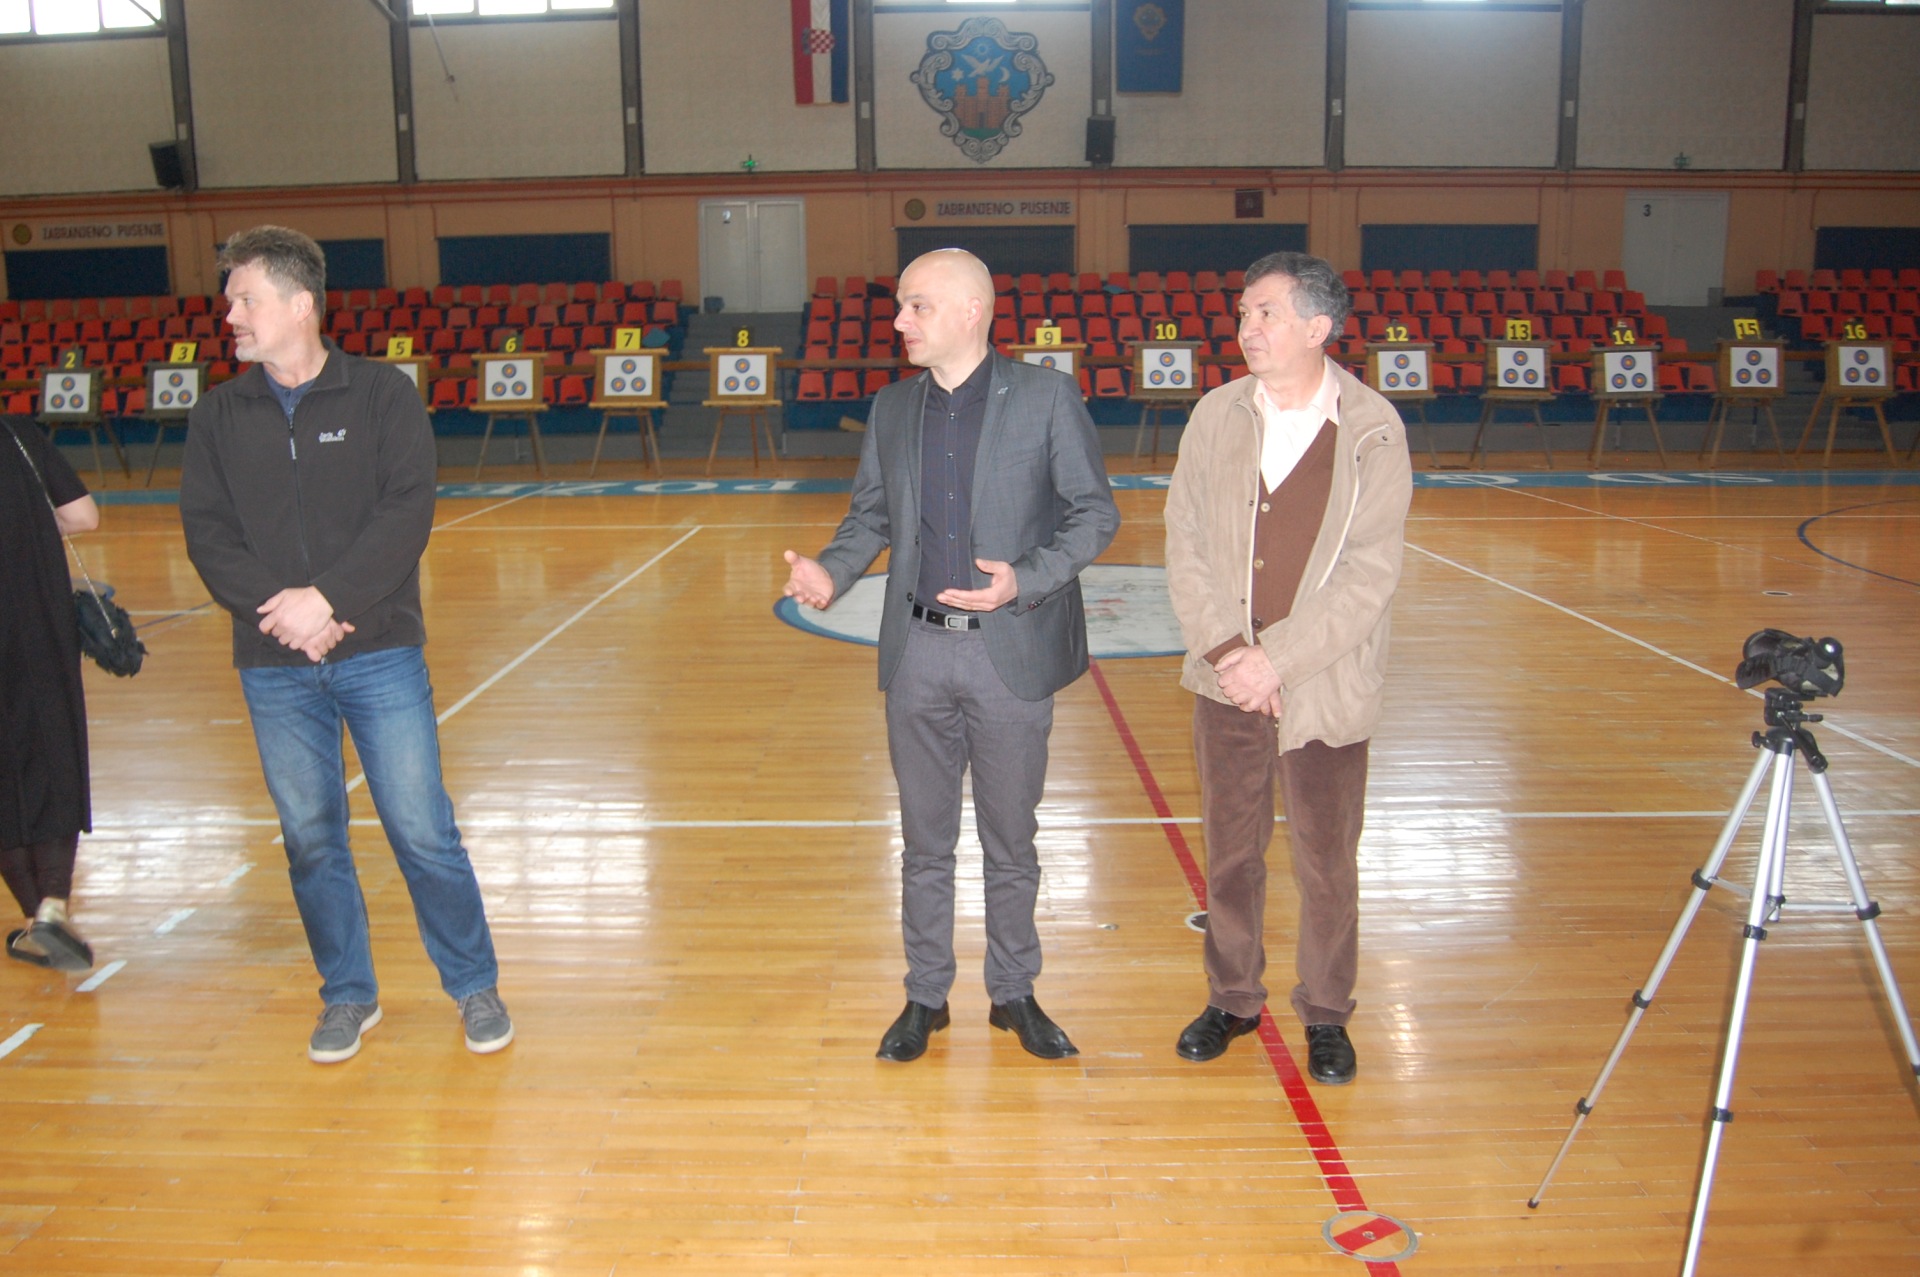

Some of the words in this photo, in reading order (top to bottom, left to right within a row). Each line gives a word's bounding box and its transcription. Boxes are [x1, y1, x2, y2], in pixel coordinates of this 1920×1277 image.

[937, 202, 1014, 216] ZABRANJENO
[1643, 204, 1651, 217] 3
[1155, 323, 1178, 340] 10
[1386, 326, 1409, 342] 12
[1509, 324, 1530, 340] 13
[1613, 329, 1636, 345] 14
[1738, 322, 1758, 337] 15
[1844, 324, 1868, 340] 16
[505, 337, 517, 353] 6
[624, 332, 634, 347] 7
[737, 329, 750, 347] 8
[1043, 331, 1054, 346] 9
[177, 346, 188, 361] 3
[395, 341, 405, 355] 5
[64, 352, 76, 369] 2
